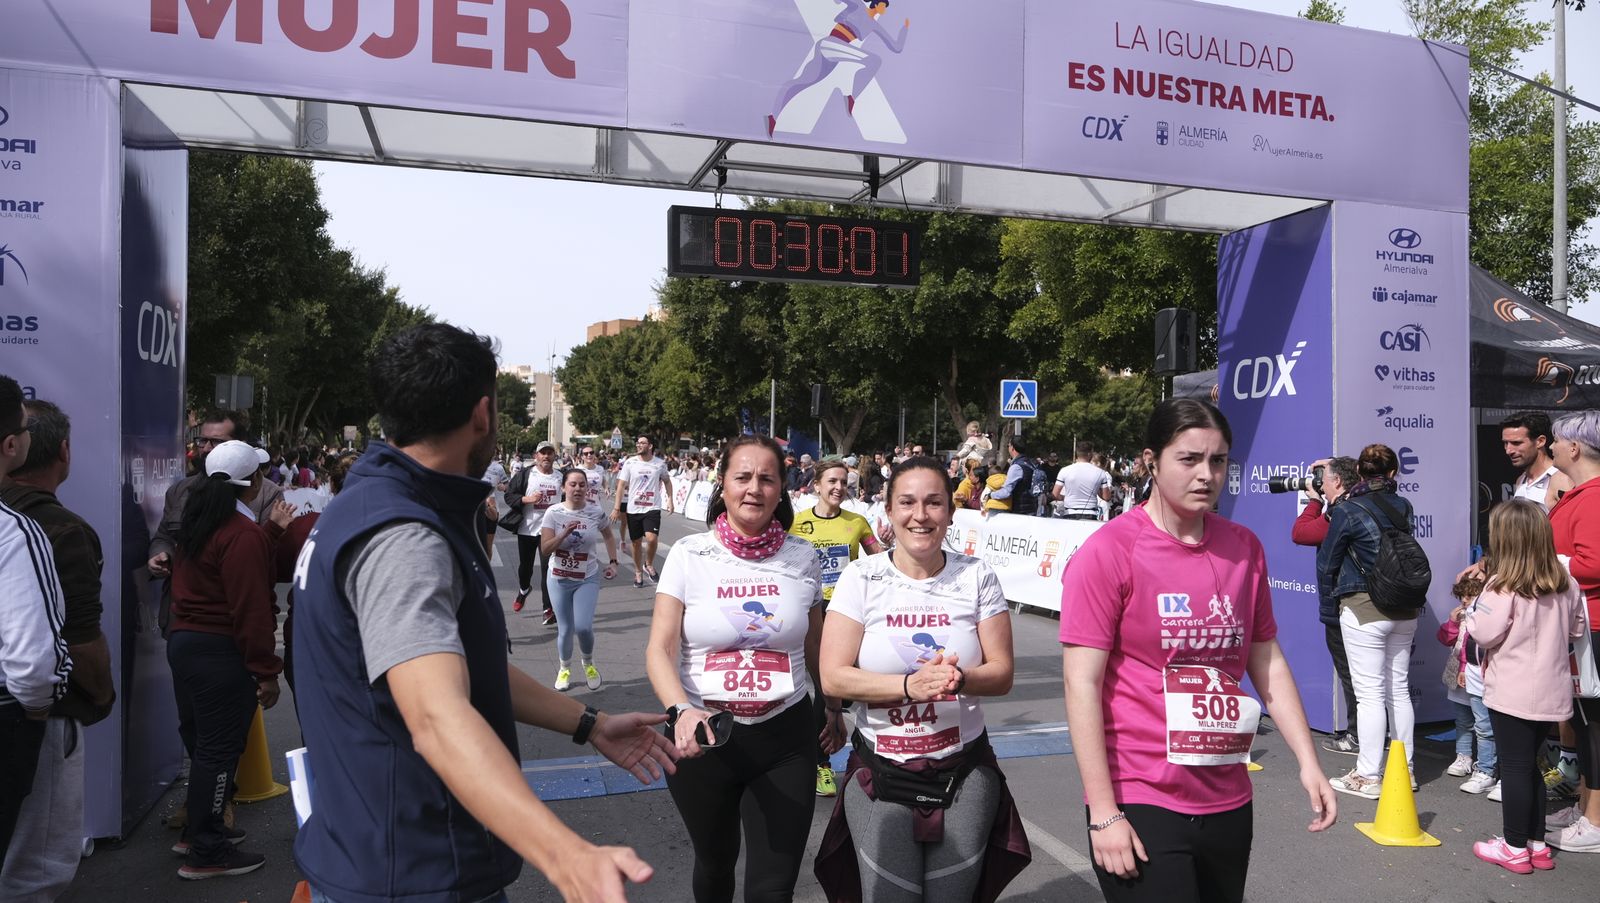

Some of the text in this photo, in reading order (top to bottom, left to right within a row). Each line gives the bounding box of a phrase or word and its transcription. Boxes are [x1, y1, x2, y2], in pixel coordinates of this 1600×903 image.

[1115, 21, 1294, 73] LA IGUALDAD
[1068, 61, 1335, 122] ES NUESTRA META.
[1082, 115, 1129, 141] CDX
[1178, 124, 1228, 143] ALMERÍA
[1178, 138, 1205, 149] CIUDAD
[714, 216, 908, 276] 00:30:01
[1376, 250, 1434, 265] HYUNDAI
[1391, 289, 1438, 304] cajamar
[137, 299, 181, 368] CDX
[1233, 341, 1307, 400] CDX
[1393, 367, 1436, 382] vithas
[1384, 413, 1434, 432] aqualia
[1250, 483, 1271, 494] CIUD
[985, 533, 1038, 558] ALMERÍA
[561, 558, 580, 569] 932
[820, 557, 839, 570] 26
[720, 577, 753, 585] CARRERA
[717, 584, 780, 599] MUJER
[889, 605, 924, 613] CARRERA
[1163, 596, 1190, 613] IX
[886, 613, 951, 628] MUJER
[723, 670, 772, 692] 845
[887, 703, 938, 727] 844
[1192, 694, 1241, 721] 508
[1198, 720, 1237, 729] MILA PEREZ
